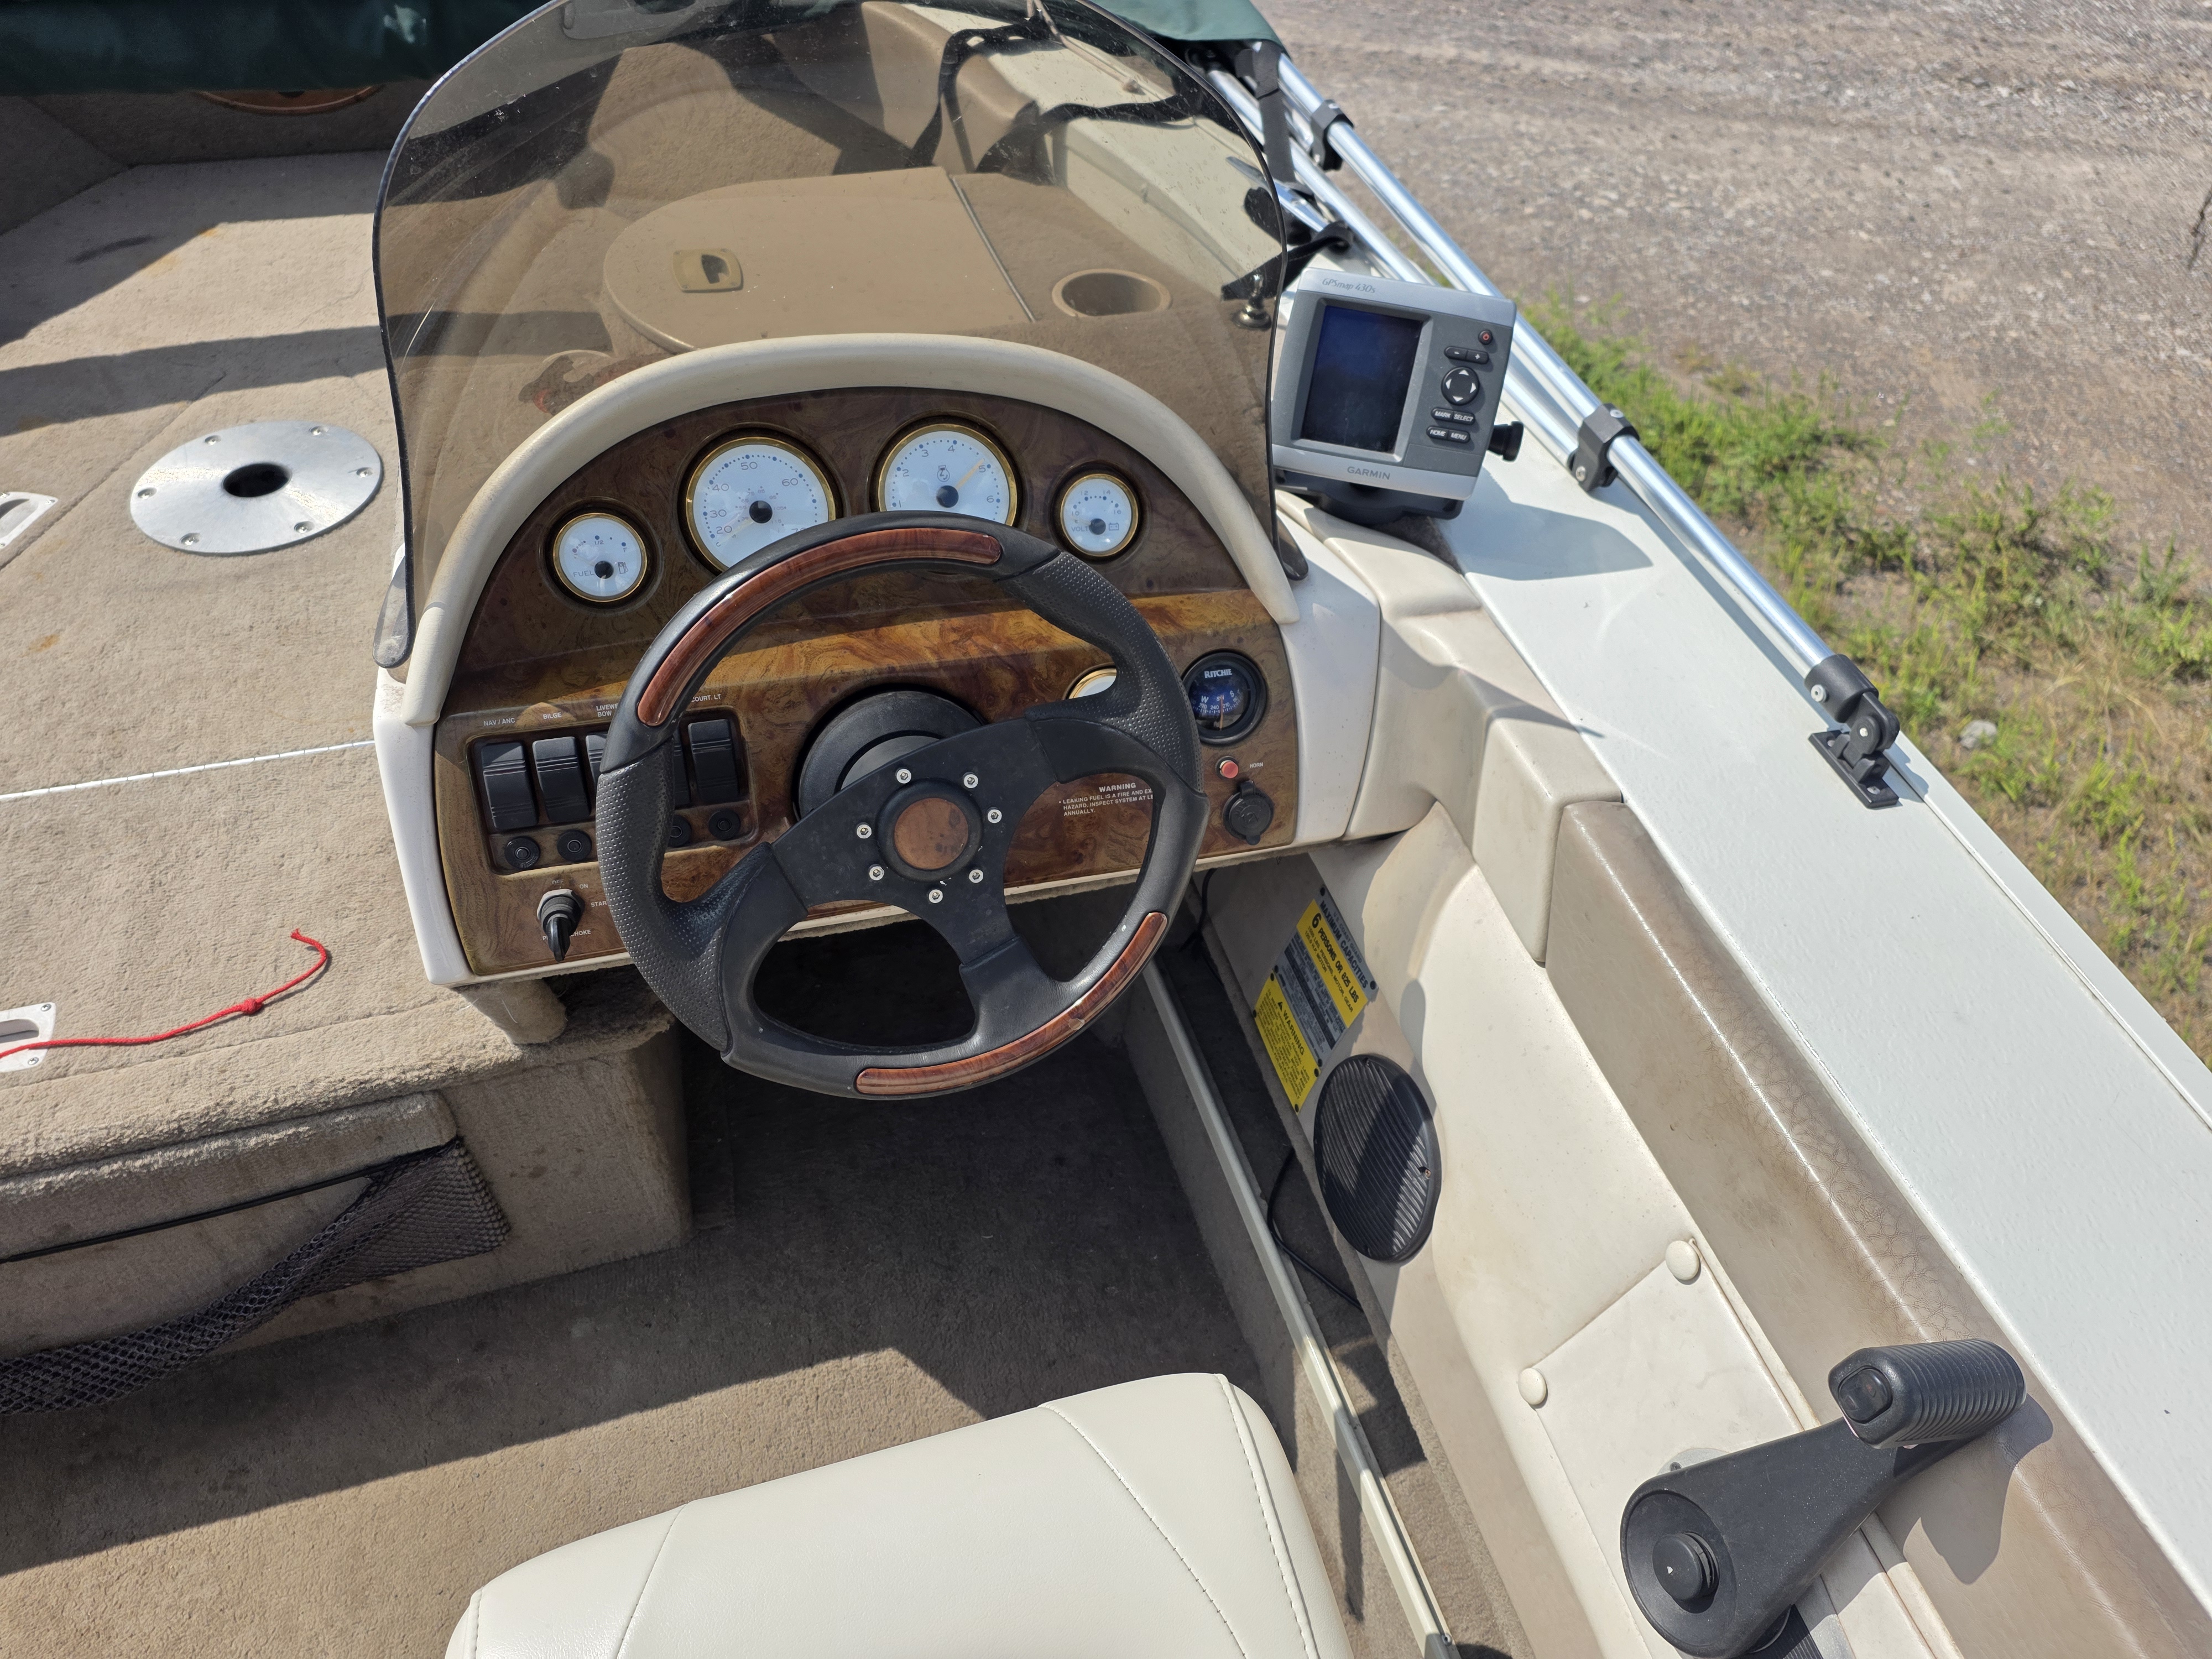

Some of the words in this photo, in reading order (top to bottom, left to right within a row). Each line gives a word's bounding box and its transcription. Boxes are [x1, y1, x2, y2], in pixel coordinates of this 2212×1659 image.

[1322, 278, 1354, 294] GPSmap
[1355, 282, 1376, 294] 430s
[1434, 411, 1451, 420] MARK
[1453, 413, 1474, 423] SELECT
[1430, 429, 1446, 439] HOME
[1450, 432, 1467, 441] MENU
[921, 449, 929, 457] 3
[947, 445, 956, 453] 4
[740, 461, 758, 470] 50
[978, 465, 987, 473] 5
[902, 469, 910, 477] 2
[1347, 466, 1391, 481] GARMIN
[712, 483, 729, 492] 40
[781, 478, 799, 487] 60
[709, 509, 727, 518] 30
[716, 525, 733, 534] 20
[1204, 669, 1232, 679] RITCHIE
[1201, 695, 1209, 703] W
[1099, 782, 1136, 792] WARNING
[1063, 808, 1096, 817] ANNUALLY.
[1320, 900, 1342, 942] MAXIMUM
[1340, 940, 1368, 989] CAPACITIES
[1340, 923, 1351, 942] COAST
[1350, 943, 1362, 963] GUARD
[1312, 912, 1322, 928] 6
[1318, 927, 1337, 962] PERSONS
[1335, 960, 1343, 974] OR
[1341, 972, 1351, 988] 825
[1348, 985, 1359, 1003] LBS
[1316, 953, 1327, 973] MOTOR
[1344, 996, 1353, 1013] GEAR
[1283, 1009, 1305, 1056] WARNING
